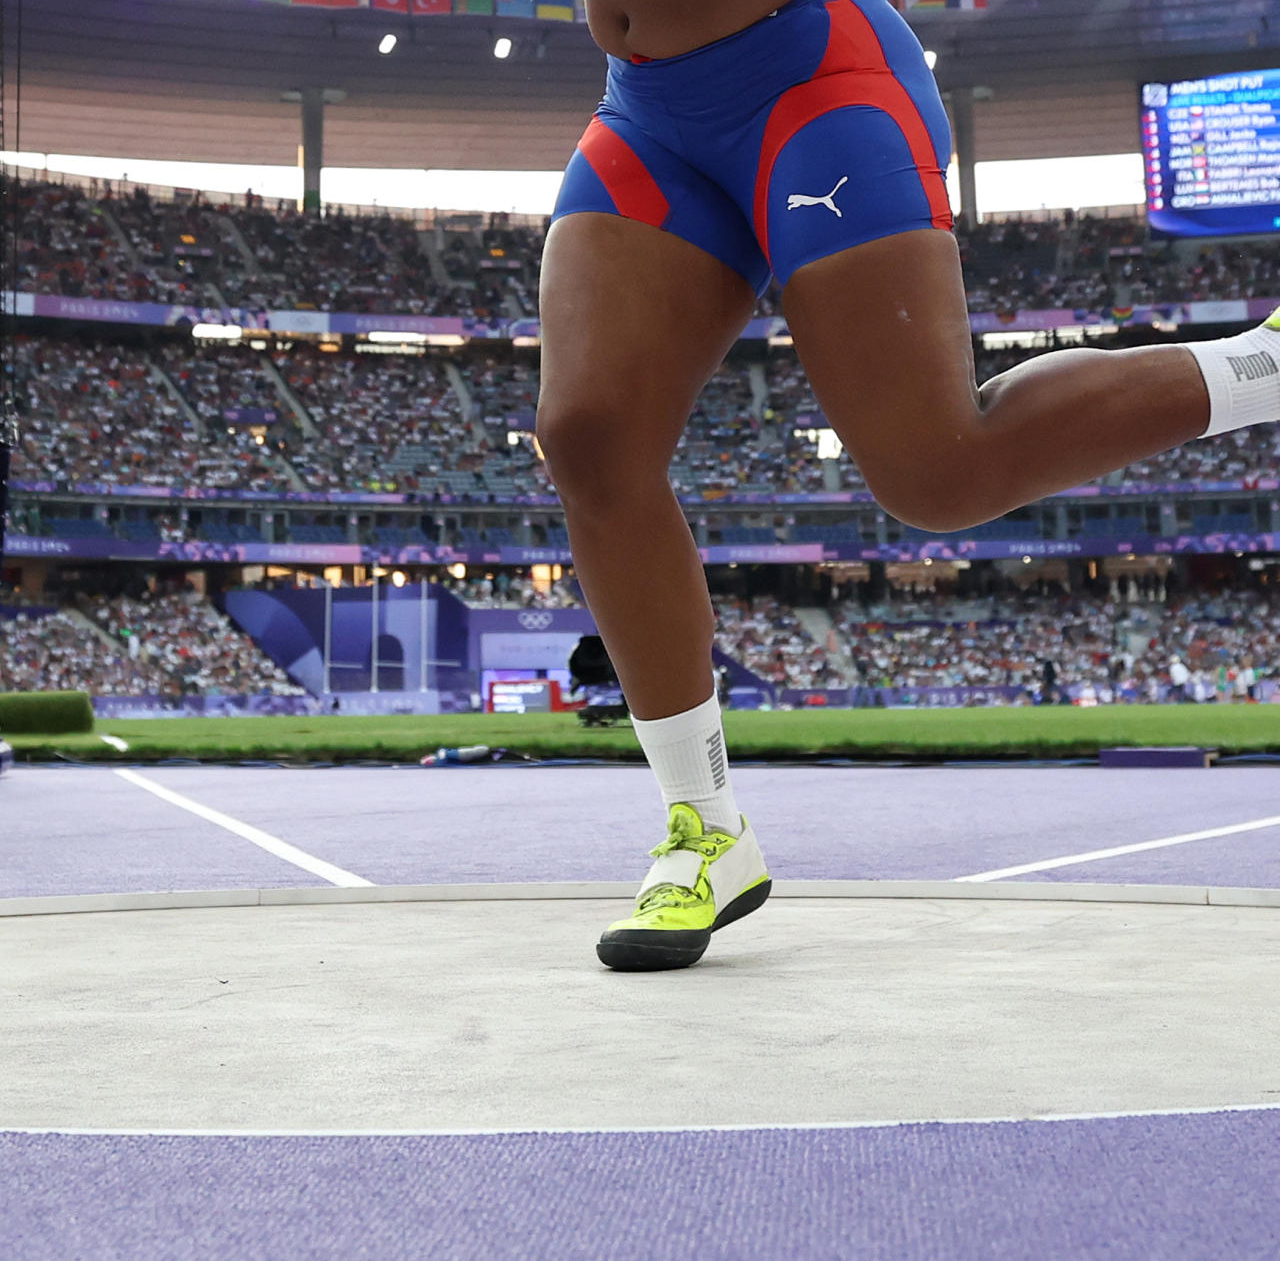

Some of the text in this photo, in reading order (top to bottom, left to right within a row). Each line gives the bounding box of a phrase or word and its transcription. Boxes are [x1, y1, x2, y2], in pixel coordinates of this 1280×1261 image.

[1170, 75, 1264, 95] MEN'S SHOT PUT
[1204, 104, 1240, 118] STANEK
[1168, 120, 1191, 133] USA
[1205, 115, 1250, 129] CROUSER
[1251, 113, 1276, 128] Ryan
[1205, 128, 1228, 142] GILL
[1206, 140, 1258, 155] CAMPBELL
[1260, 176, 1280, 190] Bob
[60, 300, 100, 316] PARIS
[1225, 351, 1279, 382] PUMA
[706, 729, 726, 791] PUMA
